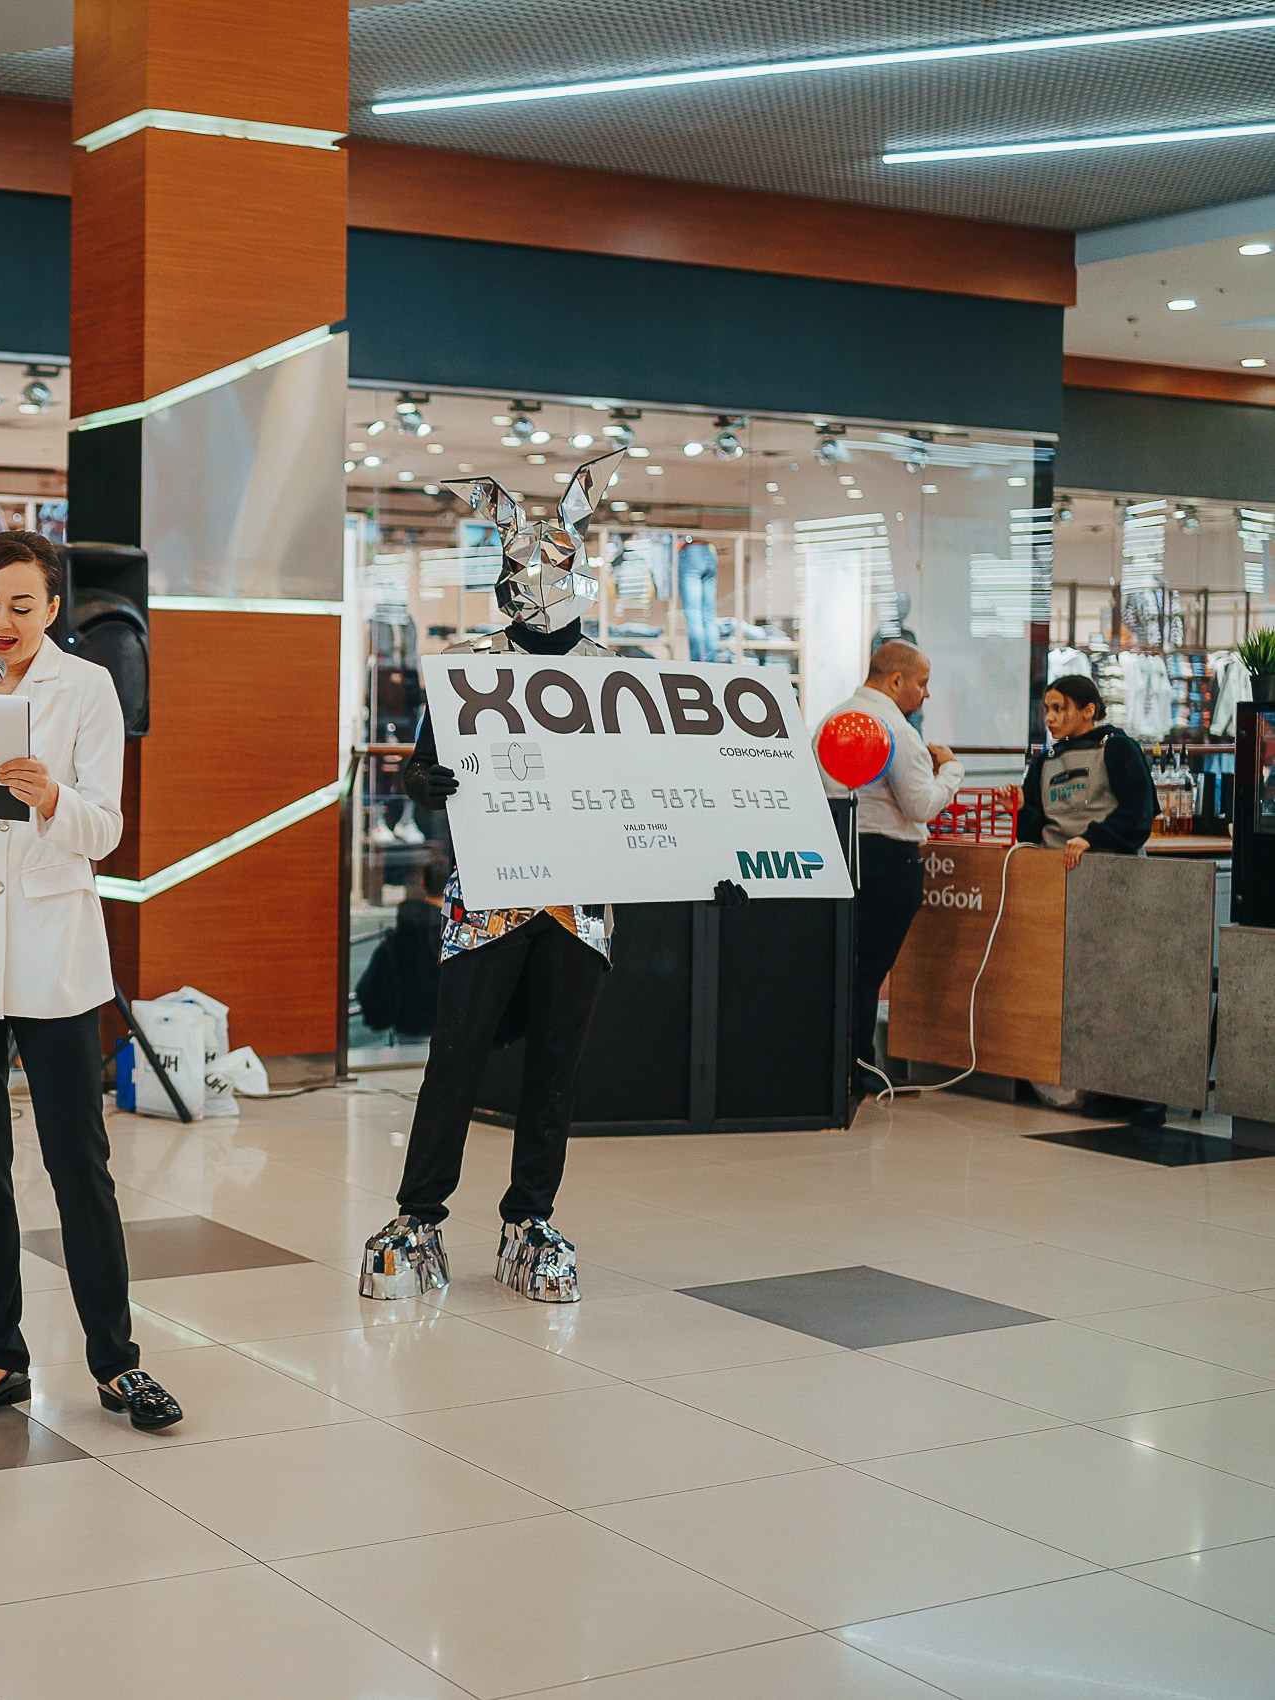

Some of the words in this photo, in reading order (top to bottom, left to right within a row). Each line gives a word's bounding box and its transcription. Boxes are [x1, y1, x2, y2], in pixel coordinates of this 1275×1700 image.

[719, 746, 795, 759] СОВКОМБАНК
[482, 790, 552, 813] 1234
[570, 788, 636, 811] 5678
[651, 788, 716, 809] 9876
[731, 789, 791, 810] 5432
[647, 823, 668, 831] THRU
[627, 835, 677, 849] 05/24
[496, 864, 552, 880] HALVA
[736, 851, 824, 879] МИР
[924, 852, 955, 878] фе
